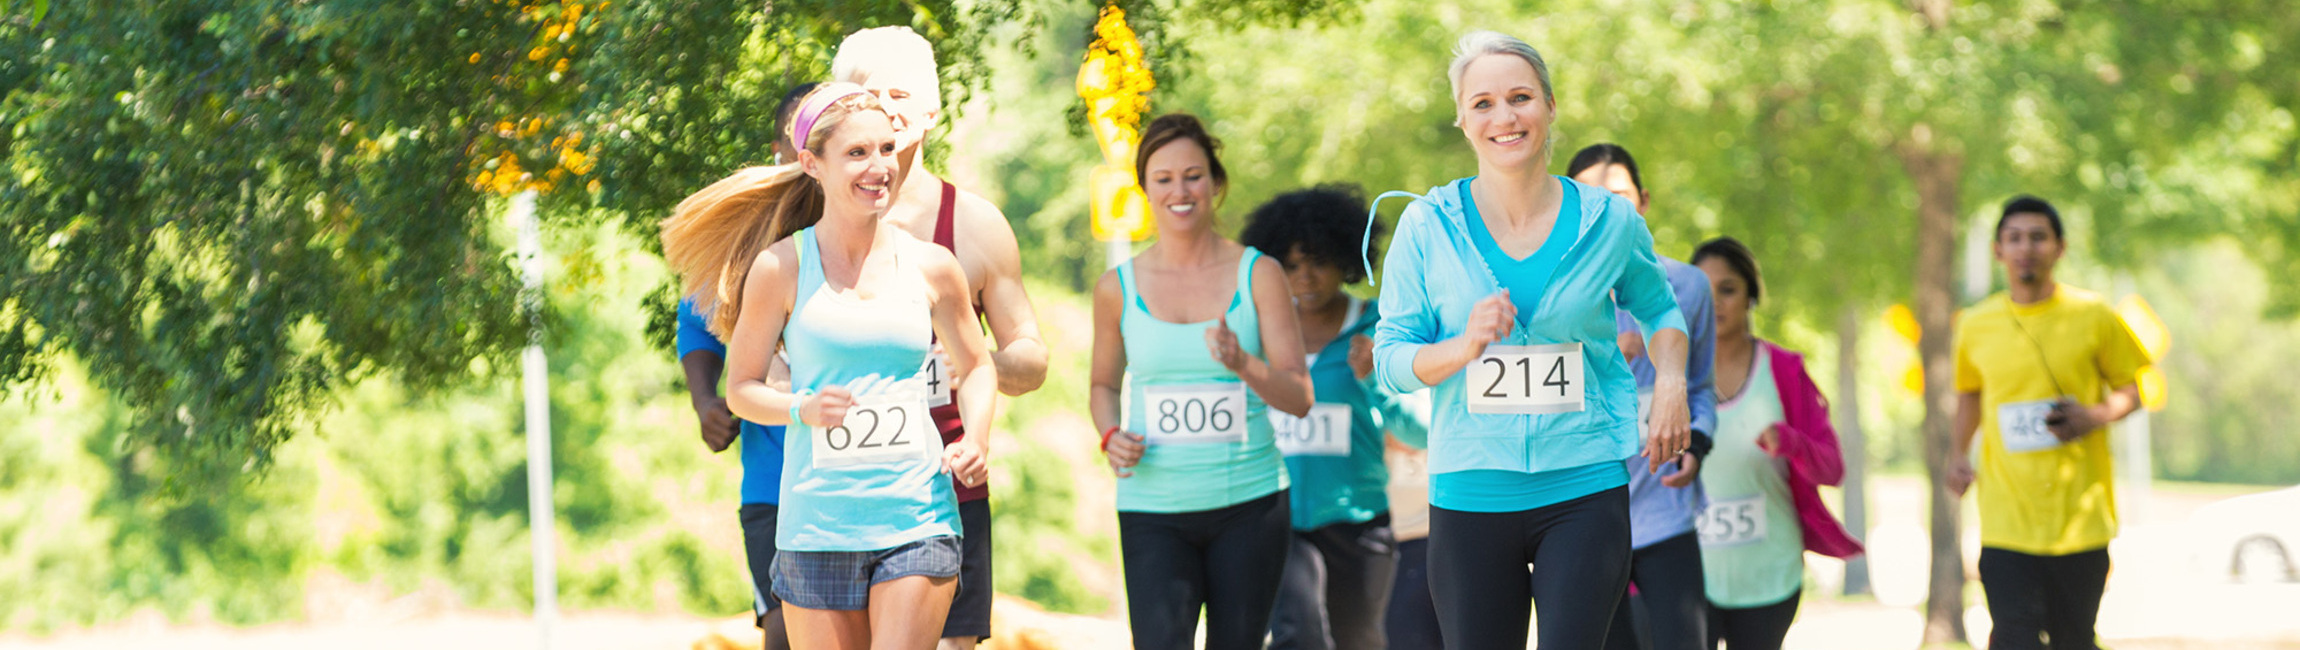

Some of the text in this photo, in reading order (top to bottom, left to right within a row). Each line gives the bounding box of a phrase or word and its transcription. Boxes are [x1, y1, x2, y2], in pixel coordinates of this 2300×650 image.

[1482, 355, 1570, 398] 214
[826, 406, 910, 451] 622
[1158, 397, 1233, 434] 806
[1276, 411, 1332, 446] 401
